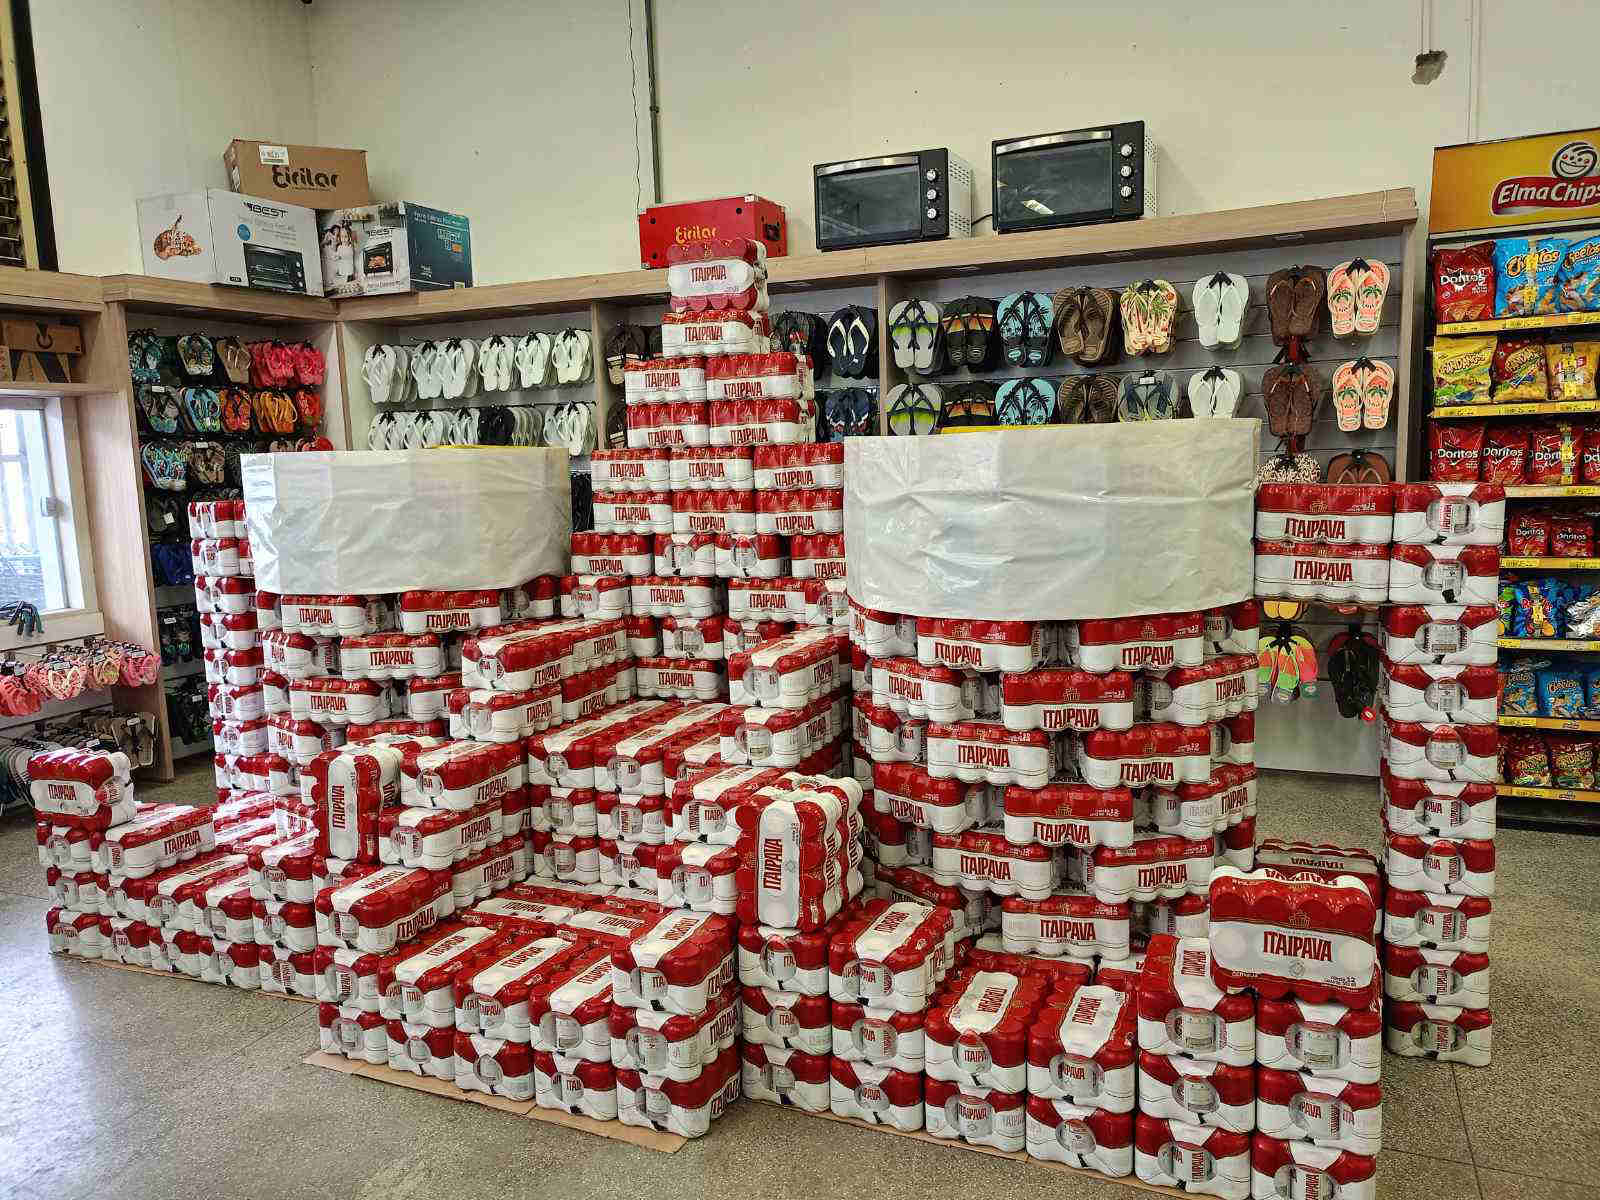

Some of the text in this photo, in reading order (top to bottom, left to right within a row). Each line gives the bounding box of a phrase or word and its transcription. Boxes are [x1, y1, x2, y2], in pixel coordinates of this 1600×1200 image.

[1498, 183, 1549, 205] Elma
[691, 265, 727, 283] ITAIPAVA
[685, 326, 723, 342] ITAIPAVA
[645, 372, 680, 387] ITAIPAVA
[724, 383, 762, 399] ITAIPAVA
[648, 430, 684, 446] ITAIPAVA
[729, 428, 768, 445] ITAIPAVA
[610, 464, 645, 478] ITAIPAVA
[689, 463, 725, 478] ITAIPAVA
[775, 471, 814, 486] ITAIPAVA
[614, 507, 650, 521] ITAIPAVA
[689, 516, 725, 530] ITAIPAVA
[776, 516, 814, 530] ITAIPAVA
[1285, 518, 1345, 540] ITAIPAVA
[589, 559, 623, 573] ITAIPAVA
[1293, 560, 1352, 581] ITAIPAVA
[650, 588, 685, 603] ITAIPAVA
[750, 593, 786, 608] ITAIPAVA
[299, 608, 333, 623] ITAIPAVA
[426, 612, 471, 628] ITAIPAVA
[369, 651, 414, 665] ITAIPAVA
[935, 642, 981, 666] ITAIPAVA
[1122, 646, 1174, 665] ITAIPAVA
[658, 672, 694, 687] ITAIPAVA
[888, 675, 922, 701] ITAIPAVA
[310, 695, 347, 711] ITAIPAVA
[1043, 708, 1099, 729] ITAIPAVA
[958, 745, 1010, 767] ITAIPAVA
[1120, 762, 1174, 782] ITAIPAVA
[48, 784, 76, 800] ITAIPAVA
[332, 784, 345, 829] ITAIPAVA
[889, 798, 924, 823] ITAIPAVA
[1033, 822, 1091, 844] ITAIPAVA
[163, 830, 200, 856] ITAIPAVA
[763, 838, 783, 891] ITAIPAVA
[960, 855, 1011, 881] ITAIPAVA
[1138, 864, 1188, 888] ITAIPAVA
[397, 906, 438, 938] ITAIPAVA
[1040, 919, 1096, 940] ITAIPAVA
[1264, 931, 1332, 962] ITAIPAVA
